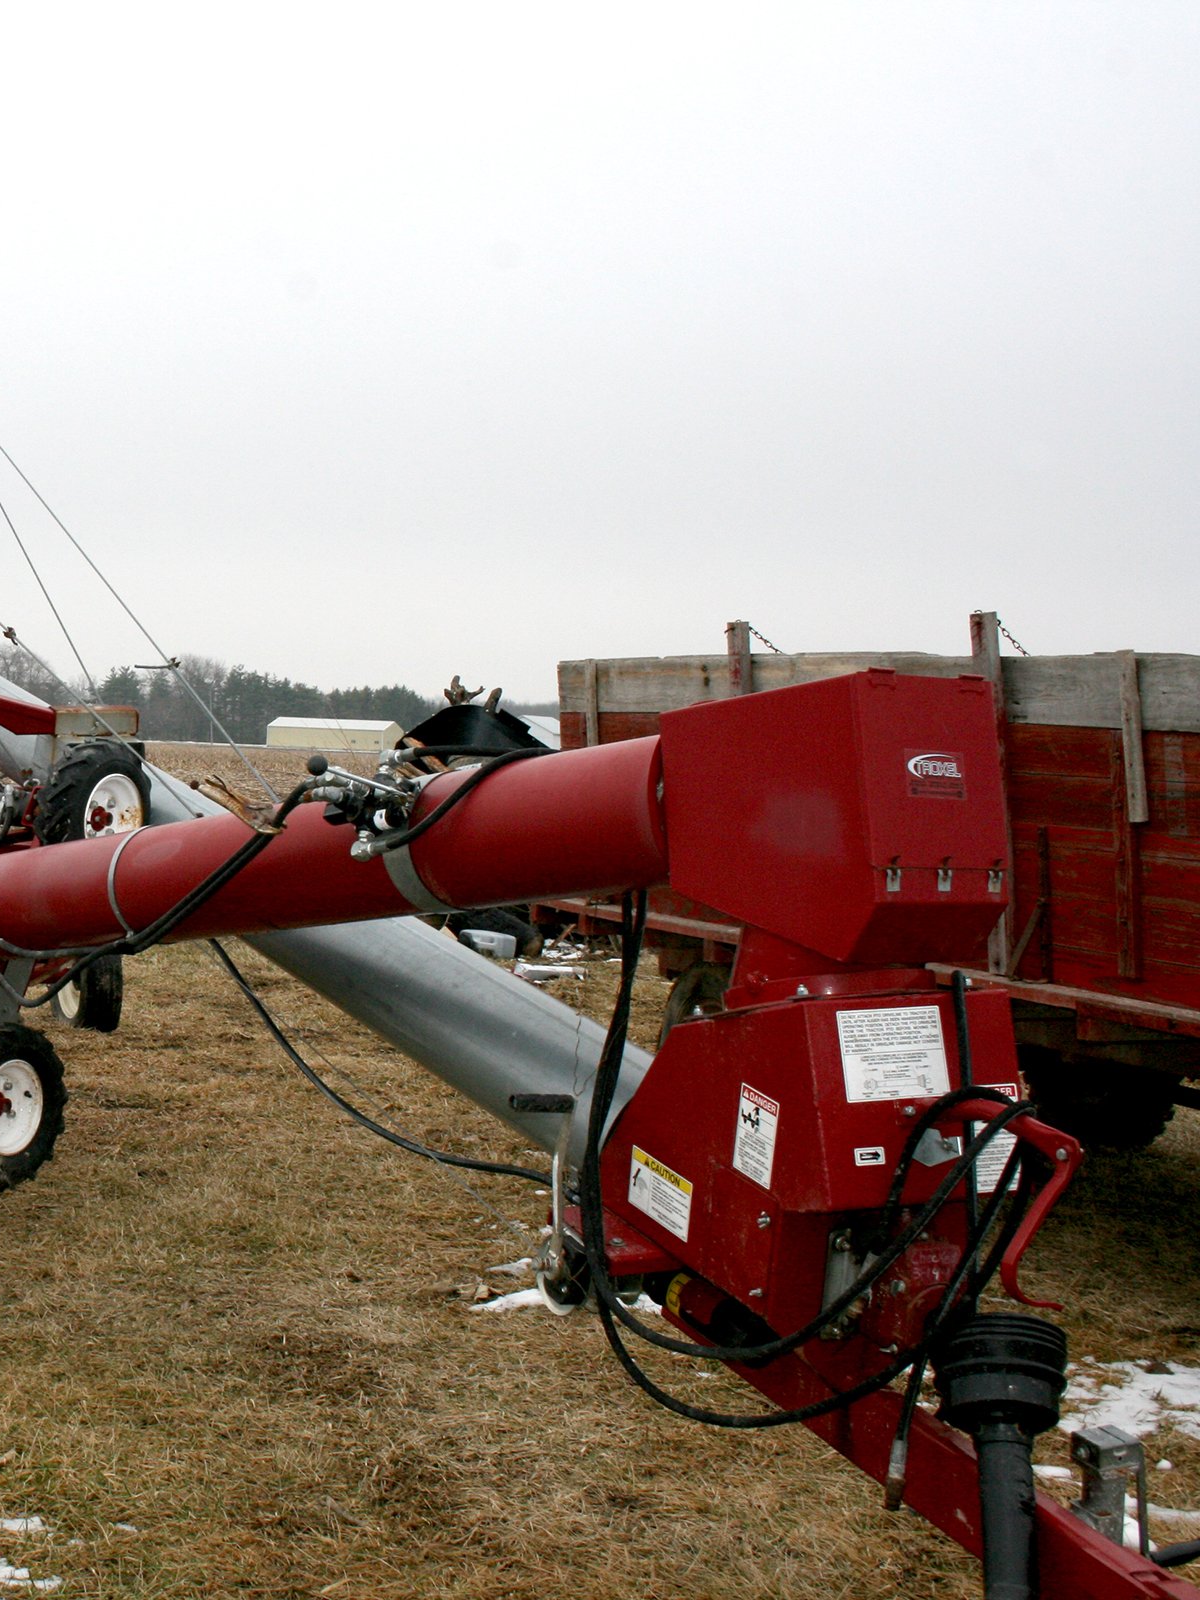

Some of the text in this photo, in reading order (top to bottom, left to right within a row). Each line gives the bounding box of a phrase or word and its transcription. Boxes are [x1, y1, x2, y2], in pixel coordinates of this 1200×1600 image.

[915, 760, 962, 778] TROXEL
[749, 1091, 777, 1115] DANGER
[650, 1160, 681, 1188] CAUTION
